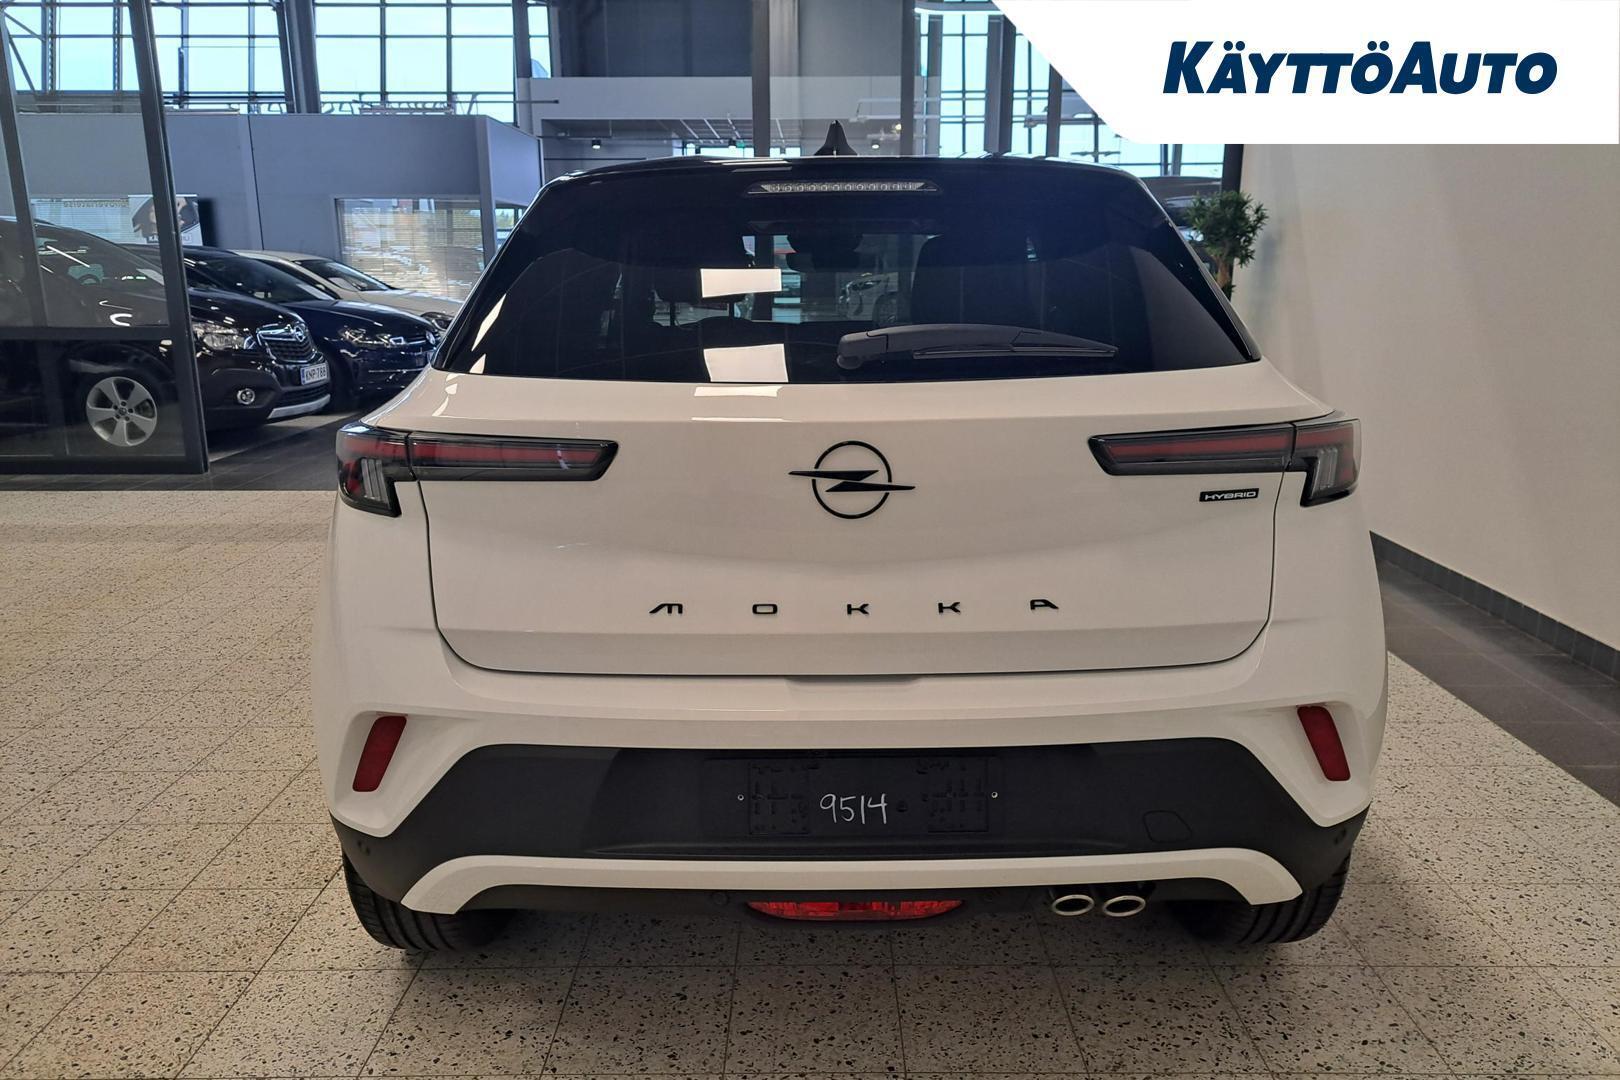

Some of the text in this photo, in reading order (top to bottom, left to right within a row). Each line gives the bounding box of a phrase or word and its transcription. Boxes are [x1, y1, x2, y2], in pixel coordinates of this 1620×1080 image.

[1204, 491, 1257, 501] HYBRID
[649, 599, 1059, 615] MOKKA
[819, 792, 888, 825] 9514
